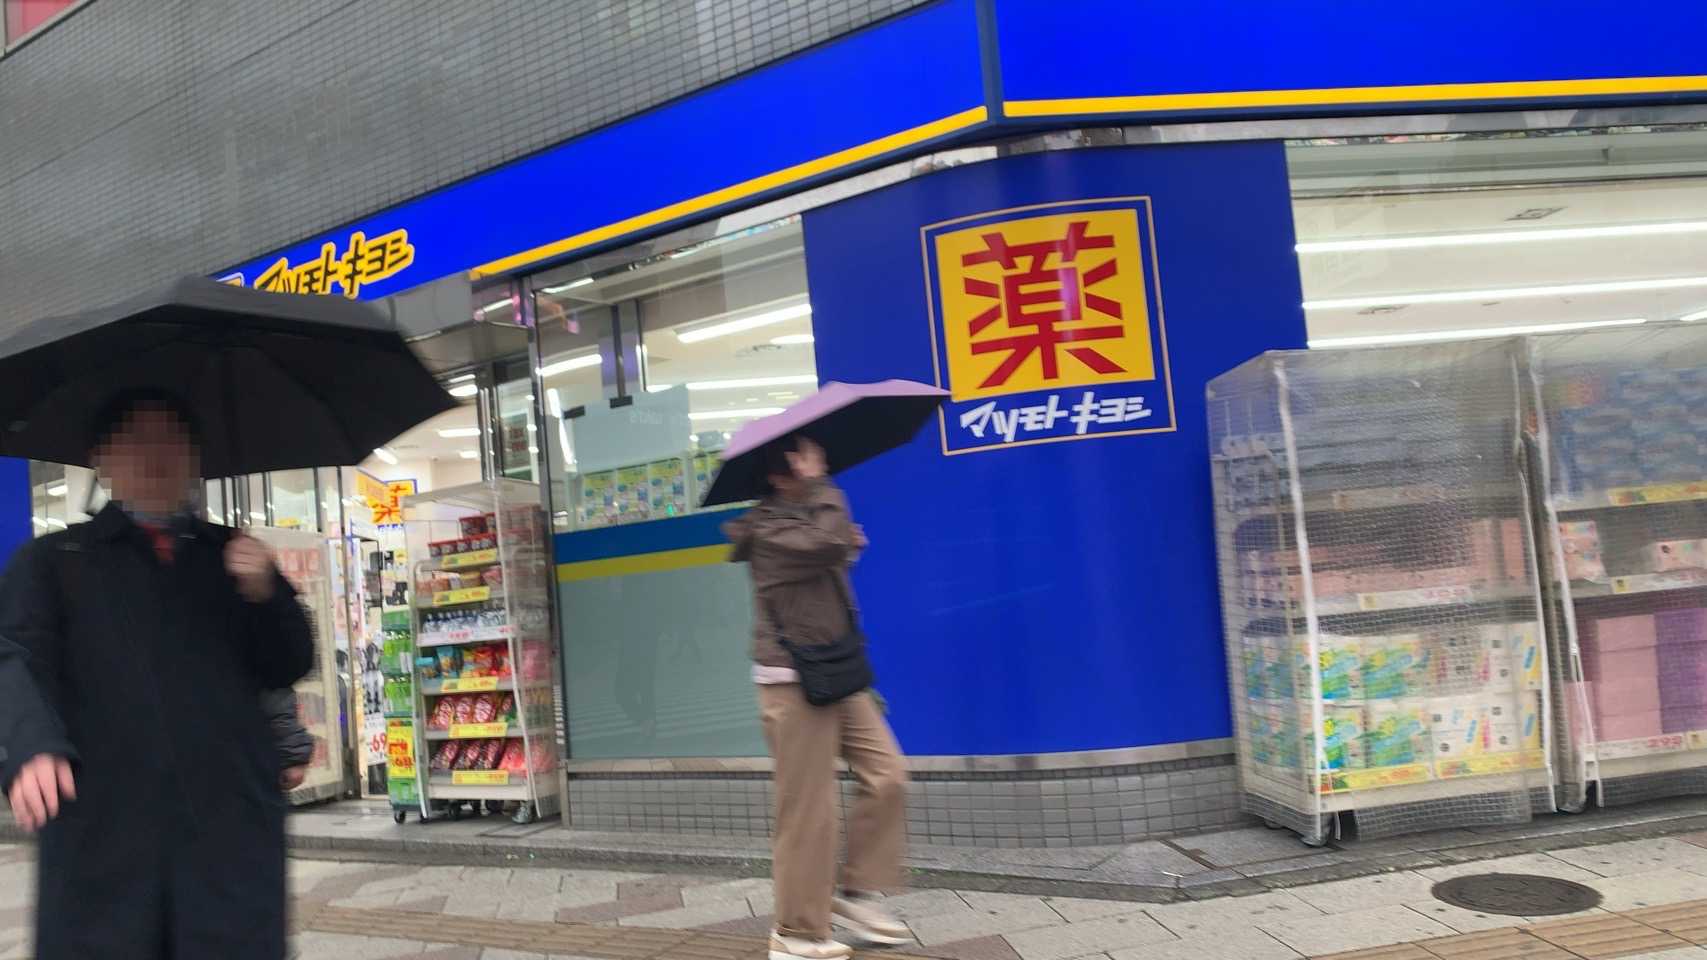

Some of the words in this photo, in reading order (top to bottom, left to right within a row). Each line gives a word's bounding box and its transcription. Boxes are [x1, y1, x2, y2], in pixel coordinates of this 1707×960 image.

[961, 220, 1128, 389] 薬
[960, 391, 1152, 442] マツモトキヨシ
